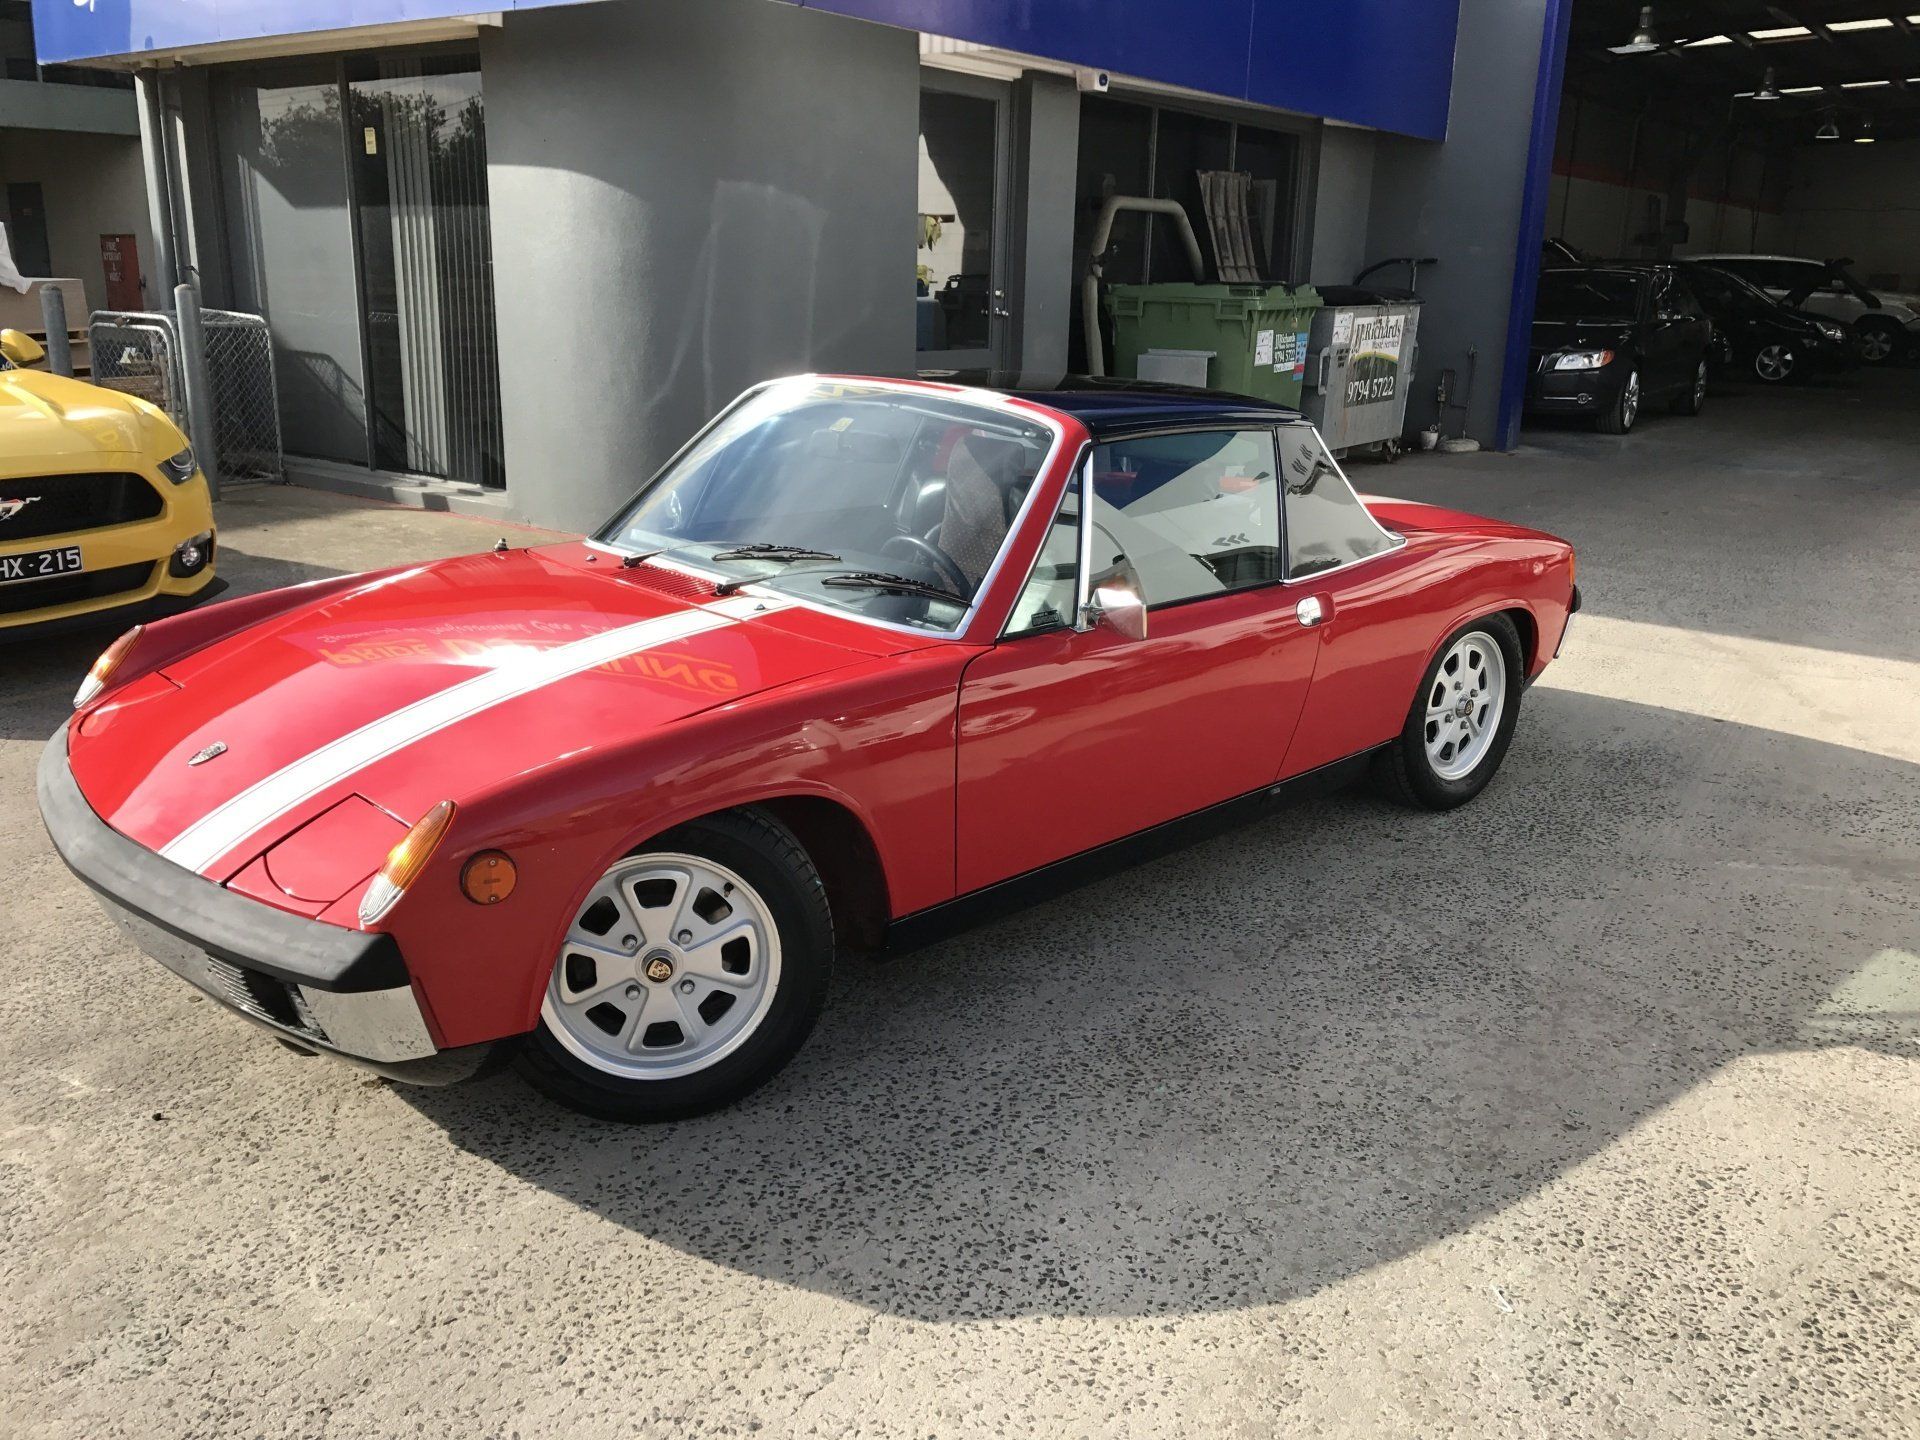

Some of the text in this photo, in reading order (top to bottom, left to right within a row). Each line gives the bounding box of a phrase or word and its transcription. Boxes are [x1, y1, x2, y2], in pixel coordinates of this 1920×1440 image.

[1347, 376, 1394, 402] 9794 5722
[38, 549, 81, 573] 215
